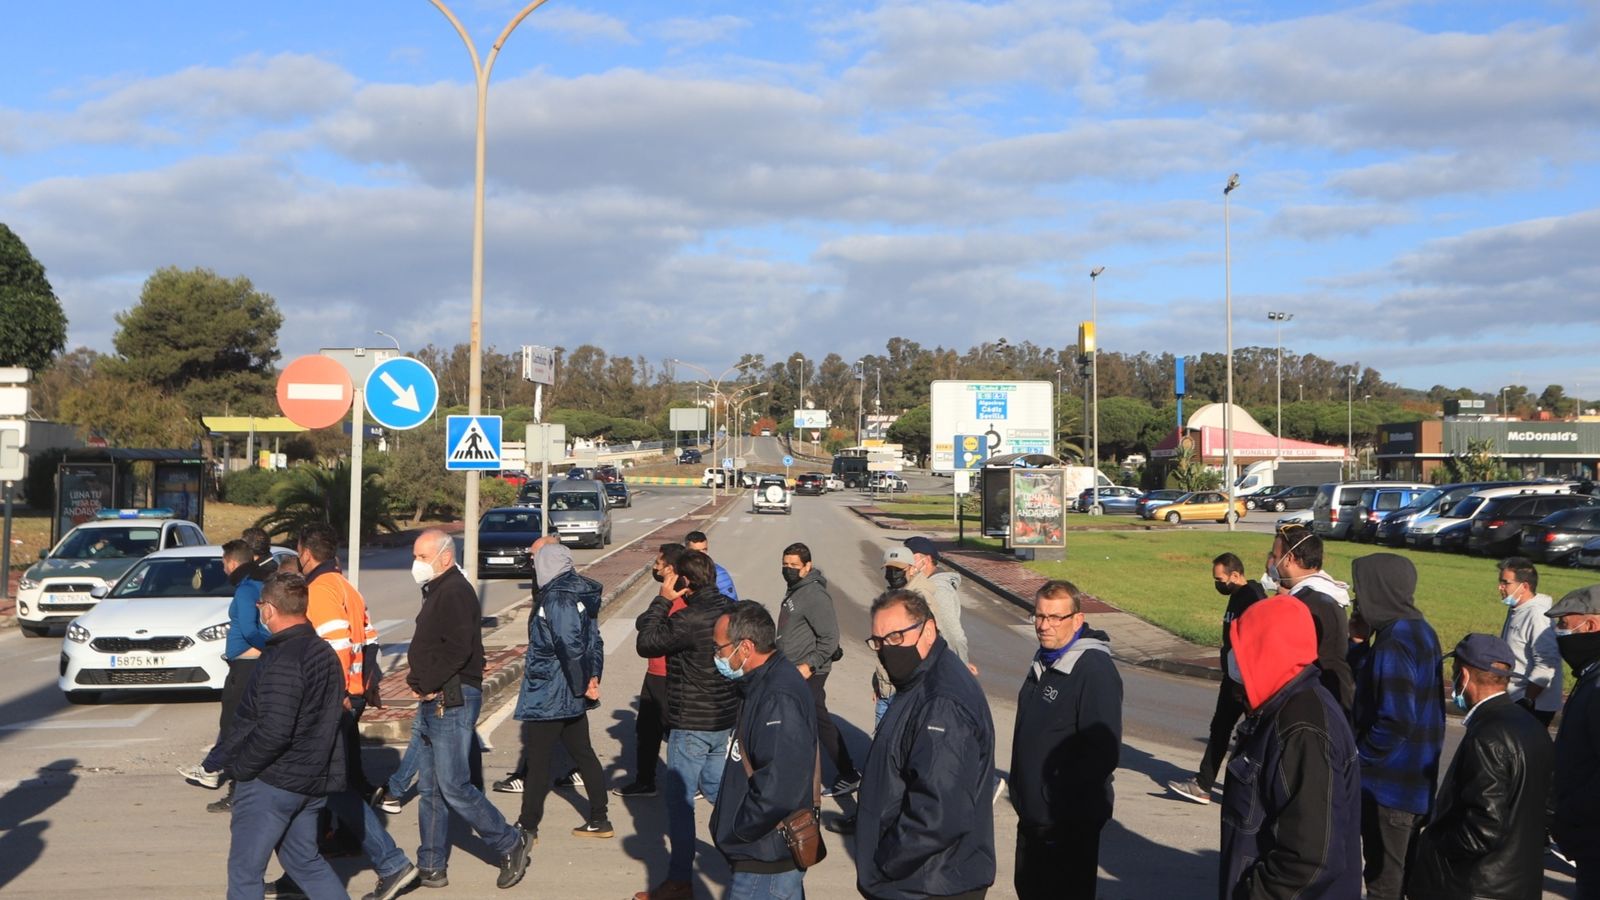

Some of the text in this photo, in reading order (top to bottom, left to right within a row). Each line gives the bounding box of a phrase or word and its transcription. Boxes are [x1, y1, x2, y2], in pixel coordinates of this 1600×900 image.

[981, 405, 1002, 413] Cádiz
[1507, 431, 1579, 442] McDonald's
[91, 490, 102, 498] TU
[117, 655, 166, 666] 5875 KWY
